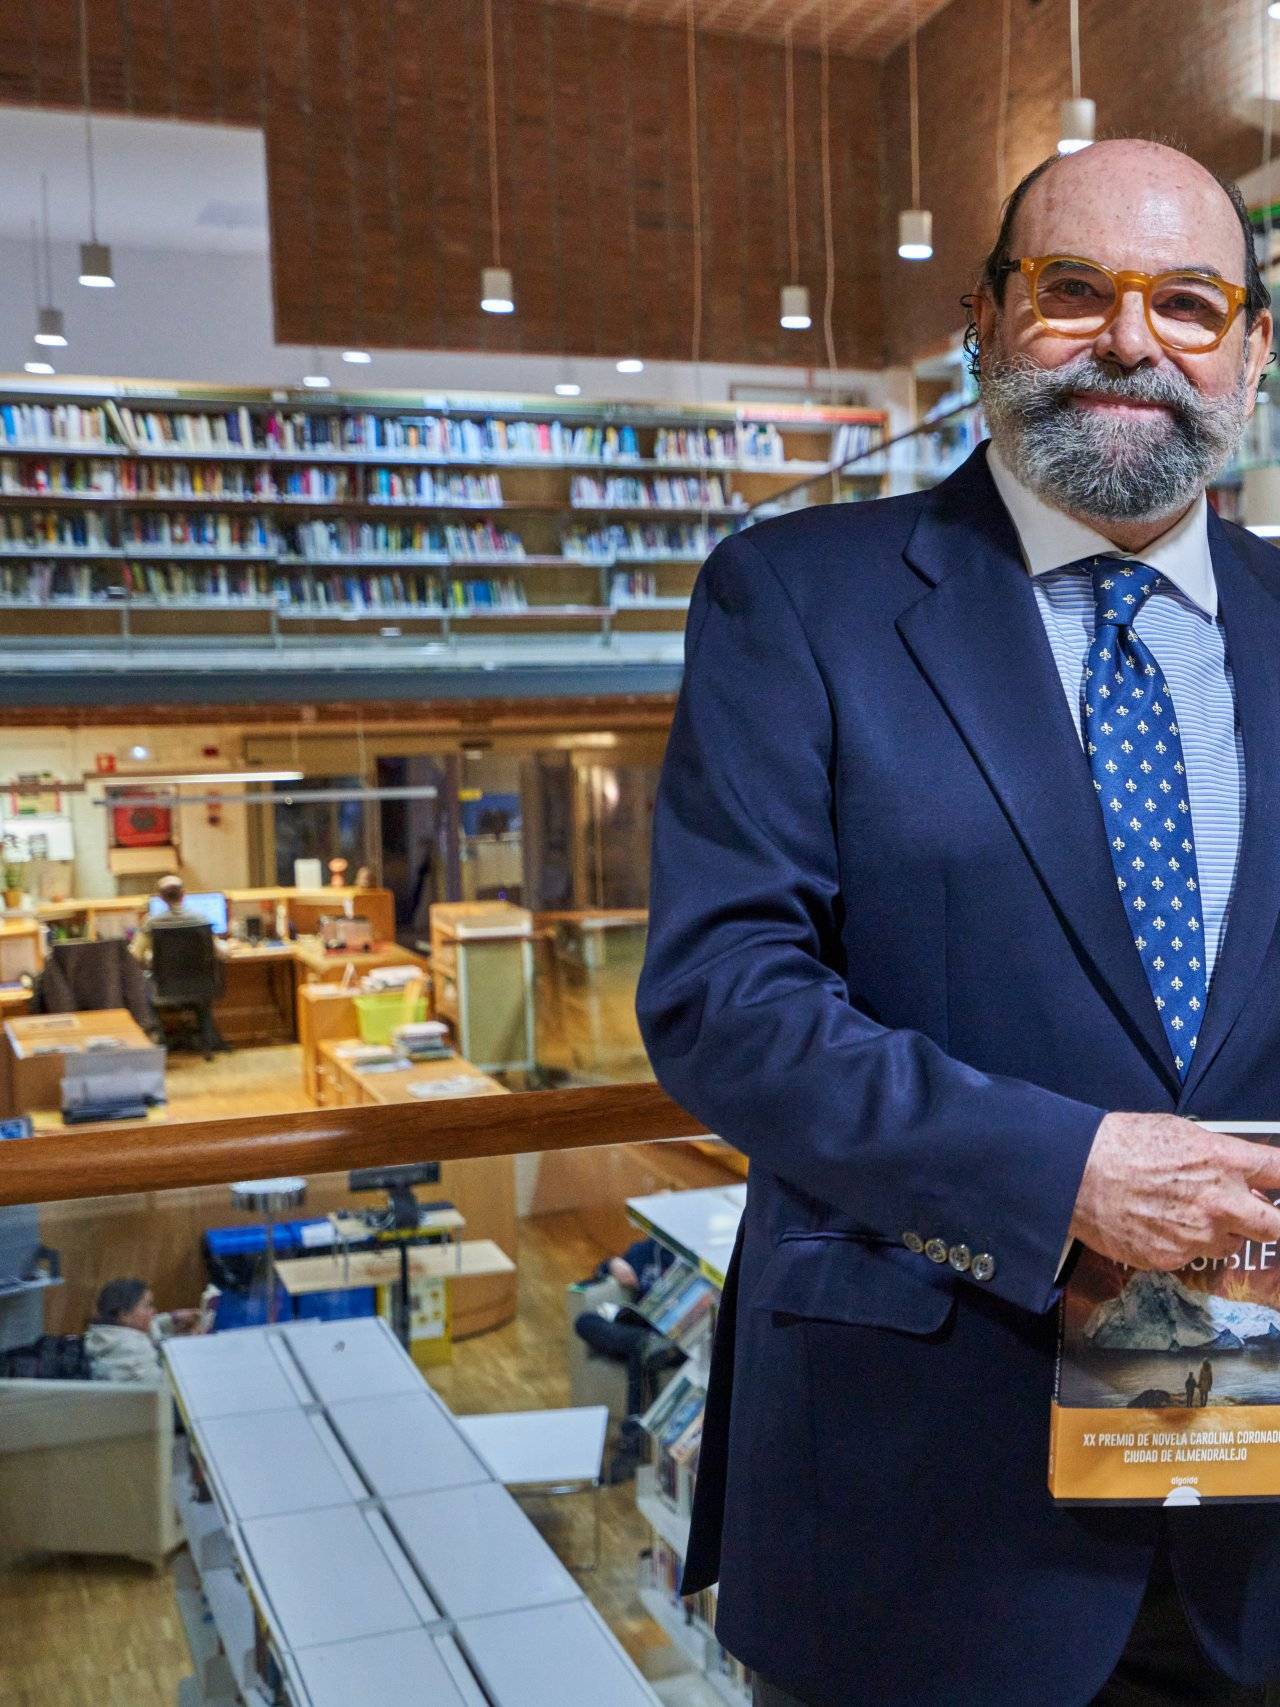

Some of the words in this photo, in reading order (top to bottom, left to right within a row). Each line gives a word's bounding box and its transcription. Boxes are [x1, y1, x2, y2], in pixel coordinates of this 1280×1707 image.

[1083, 1433, 1096, 1447] XX
[1098, 1433, 1135, 1447] PREMIO
[1137, 1433, 1149, 1446] DE
[1152, 1432, 1188, 1446] NOVELA
[1189, 1431, 1234, 1445] CAROLINA
[1124, 1450, 1158, 1463] CIUDAD
[1161, 1449, 1172, 1463] DE
[1174, 1447, 1248, 1463] ALMENDRALEJO
